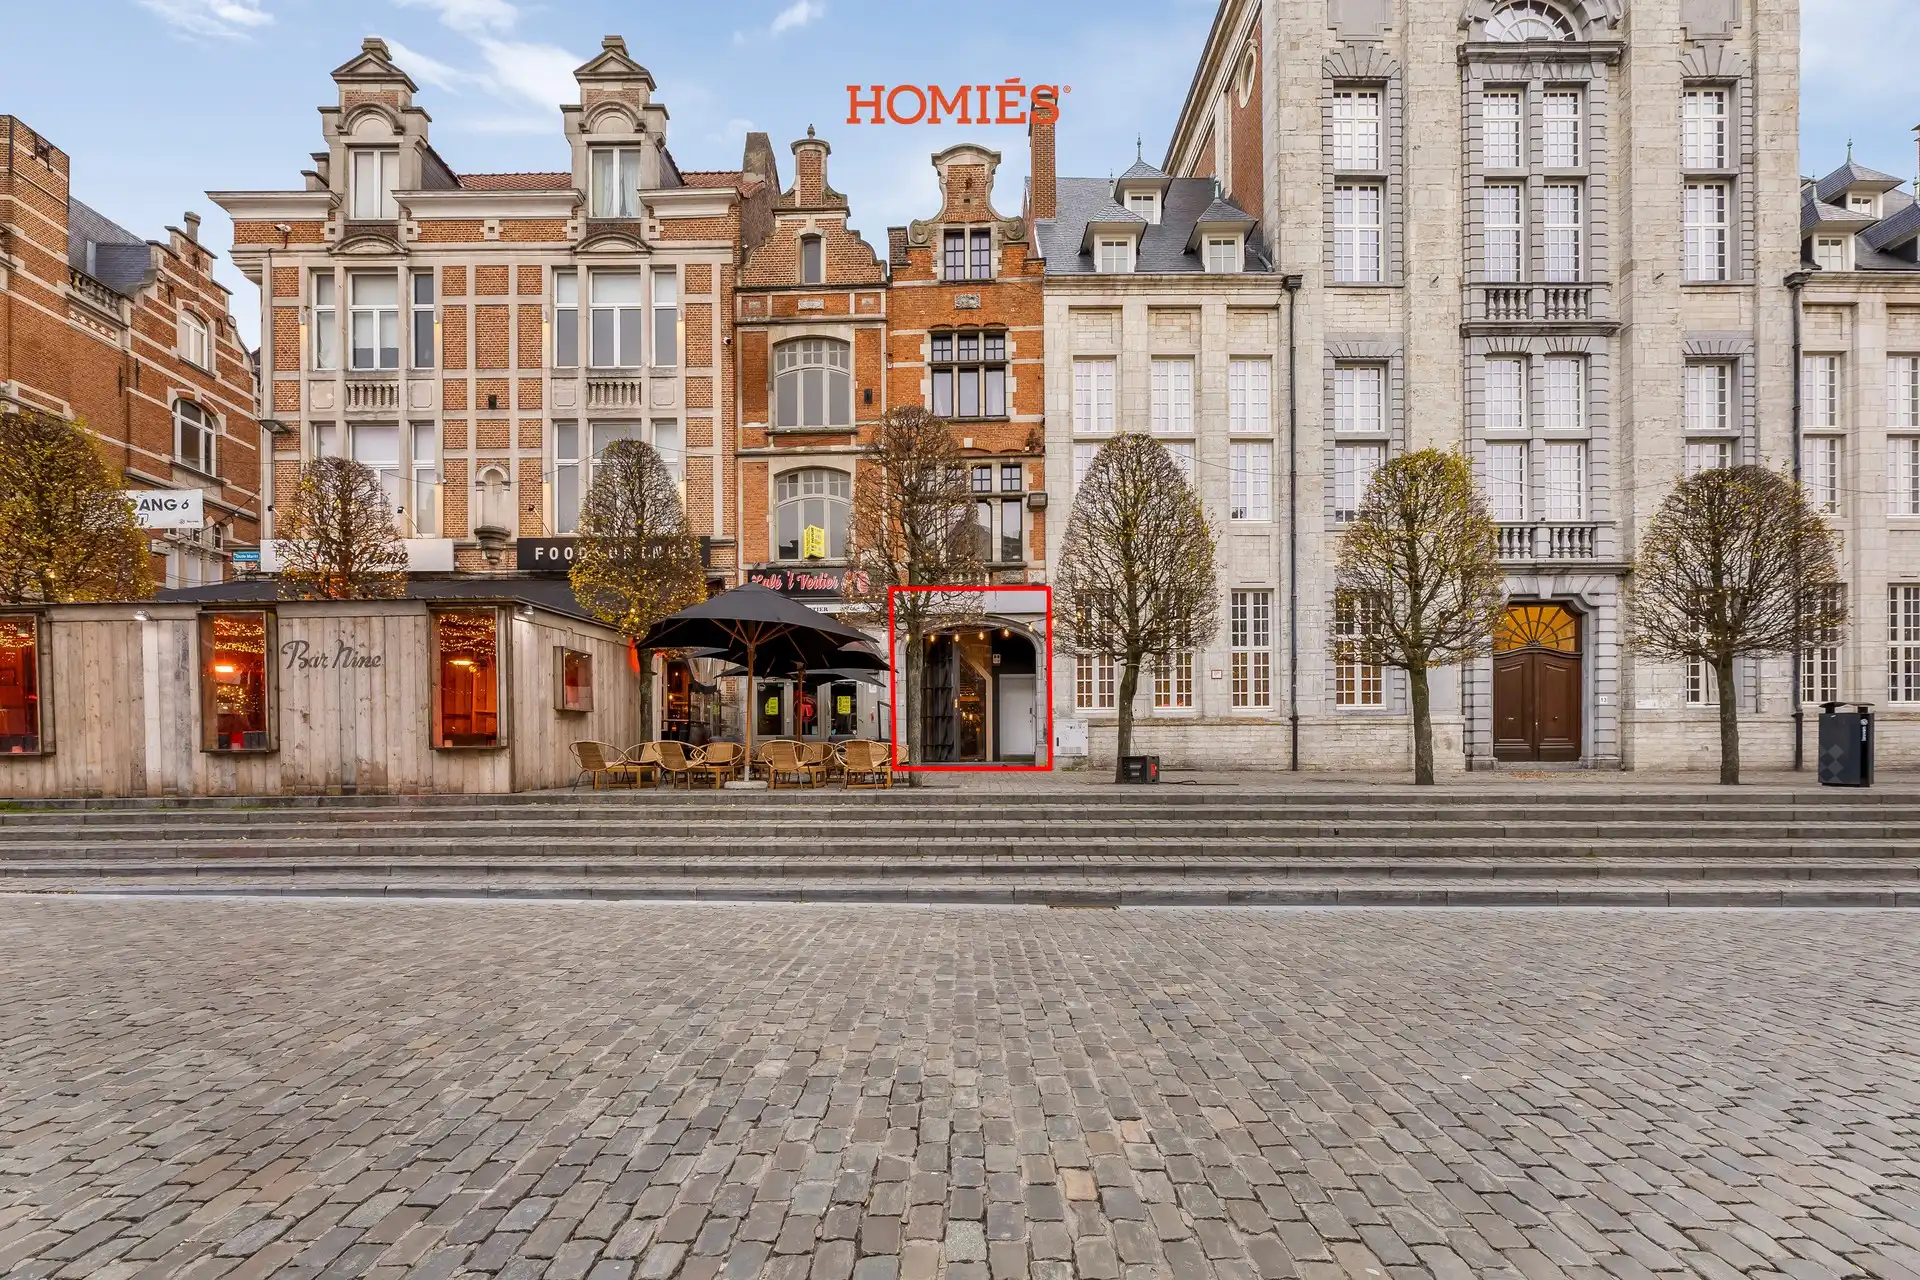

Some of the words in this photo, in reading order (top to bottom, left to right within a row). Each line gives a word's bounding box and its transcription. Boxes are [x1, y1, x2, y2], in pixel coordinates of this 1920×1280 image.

[132, 498, 177, 511] ANG
[181, 498, 189, 510] 6
[280, 640, 328, 670] Bar
[332, 638, 382, 669] Nine
